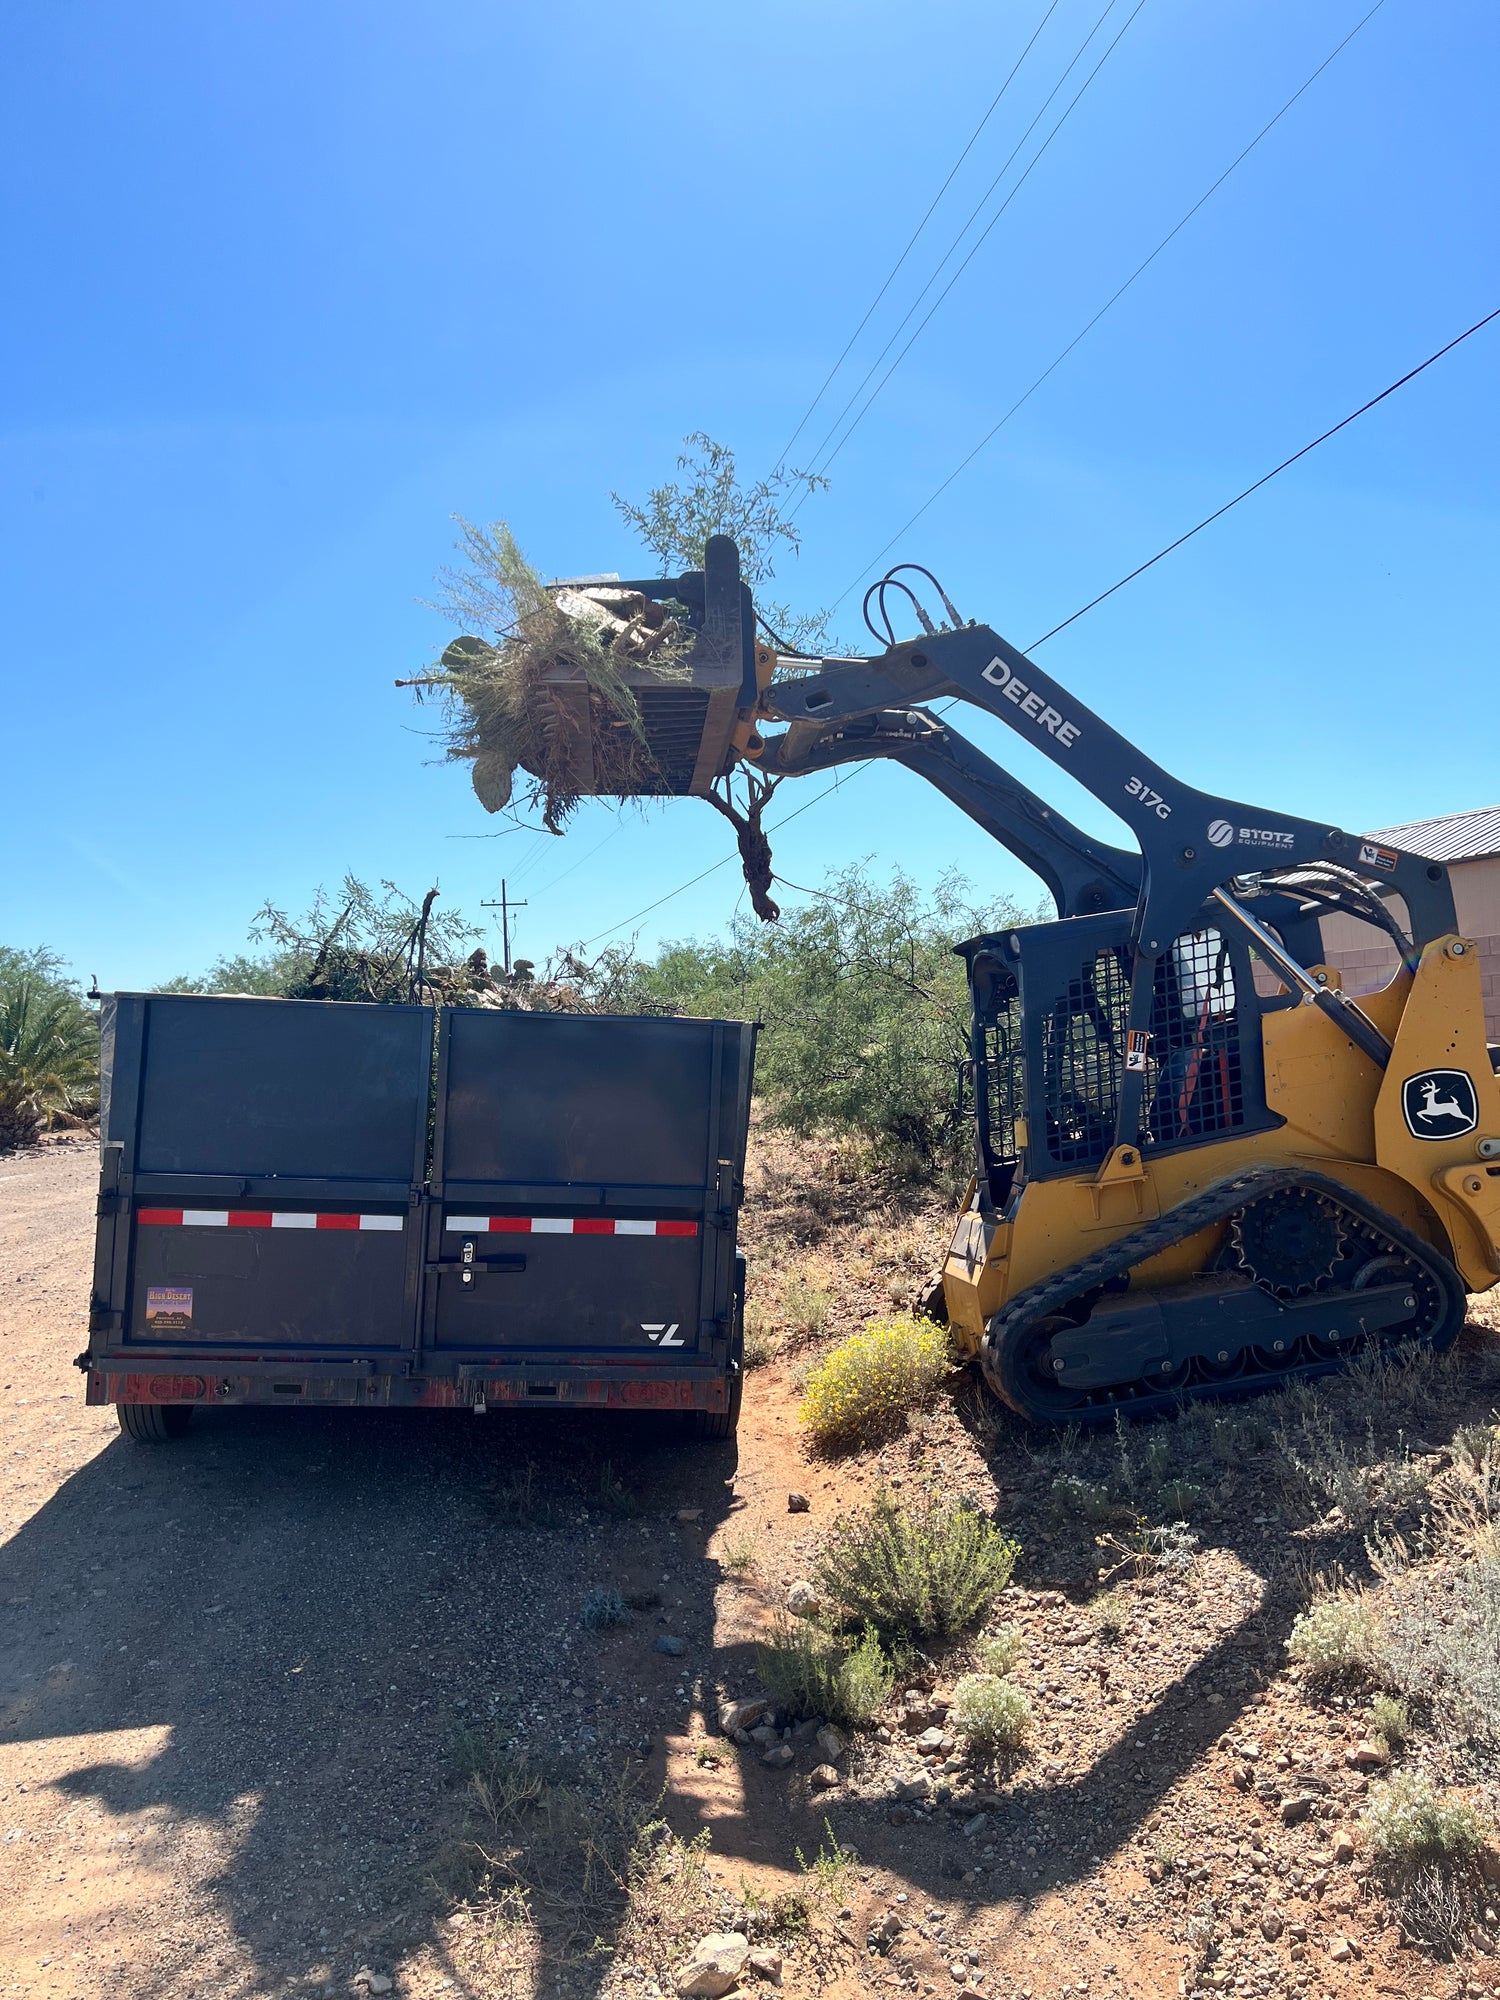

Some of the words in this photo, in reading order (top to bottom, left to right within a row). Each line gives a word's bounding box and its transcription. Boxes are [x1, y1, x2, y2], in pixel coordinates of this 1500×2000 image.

[981, 656, 1081, 748] DEERE
[1124, 776, 1172, 819] 317G
[1239, 828, 1294, 843] STOTZ
[1239, 838, 1294, 849] EQUIPMENT
[149, 1291, 165, 1300] HIGH
[167, 1291, 191, 1300] DESERT
